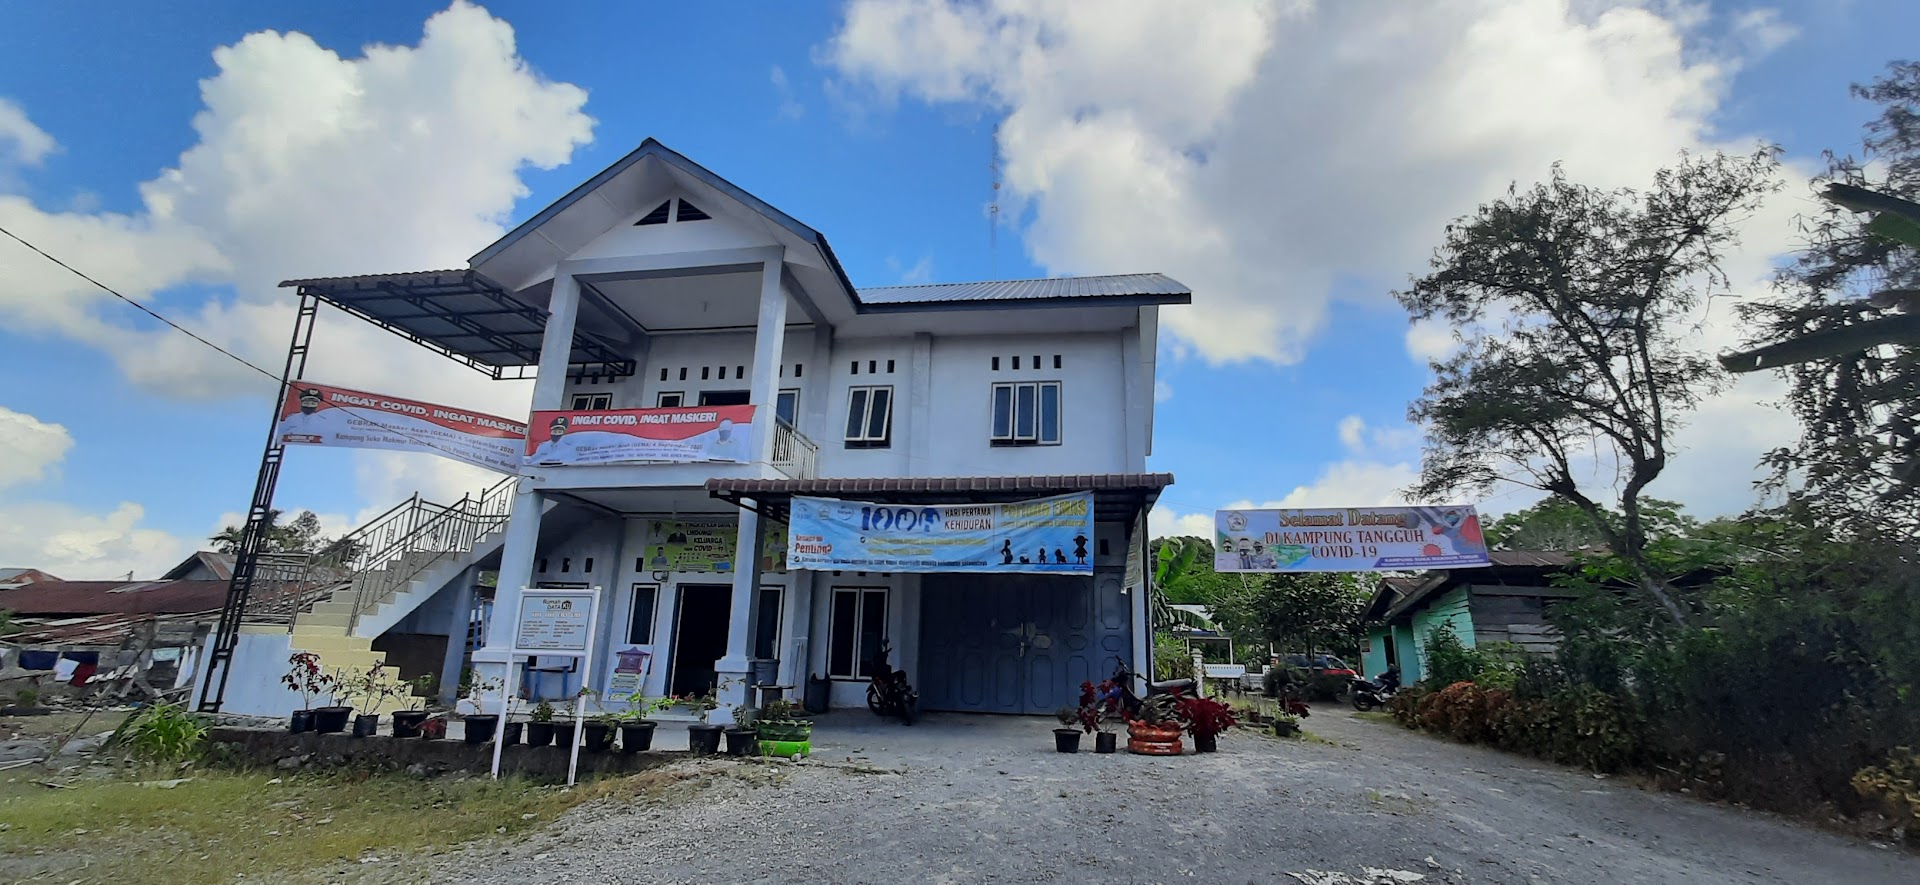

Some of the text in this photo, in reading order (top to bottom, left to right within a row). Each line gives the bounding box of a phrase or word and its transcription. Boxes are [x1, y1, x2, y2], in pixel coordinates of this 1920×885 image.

[331, 393, 378, 407] INGAT
[380, 401, 430, 417] COVID,
[433, 409, 475, 424] INGAT
[571, 412, 717, 426] INGAT COVID, INGAT MASKER!
[336, 433, 365, 443] Kampung
[410, 426, 429, 434] Aceh
[430, 430, 456, 440] (GEMA)
[500, 445, 515, 454] 2020
[945, 508, 961, 517] HARI
[962, 507, 991, 517] PERTAMA
[1279, 508, 1407, 528] Selamat Datang
[944, 518, 991, 530] KEHIDUPAN
[1264, 529, 1424, 544] DI KAMPUNG TANGGUH
[794, 542, 832, 556] Penting?
[1311, 545, 1377, 559] COVID-19
